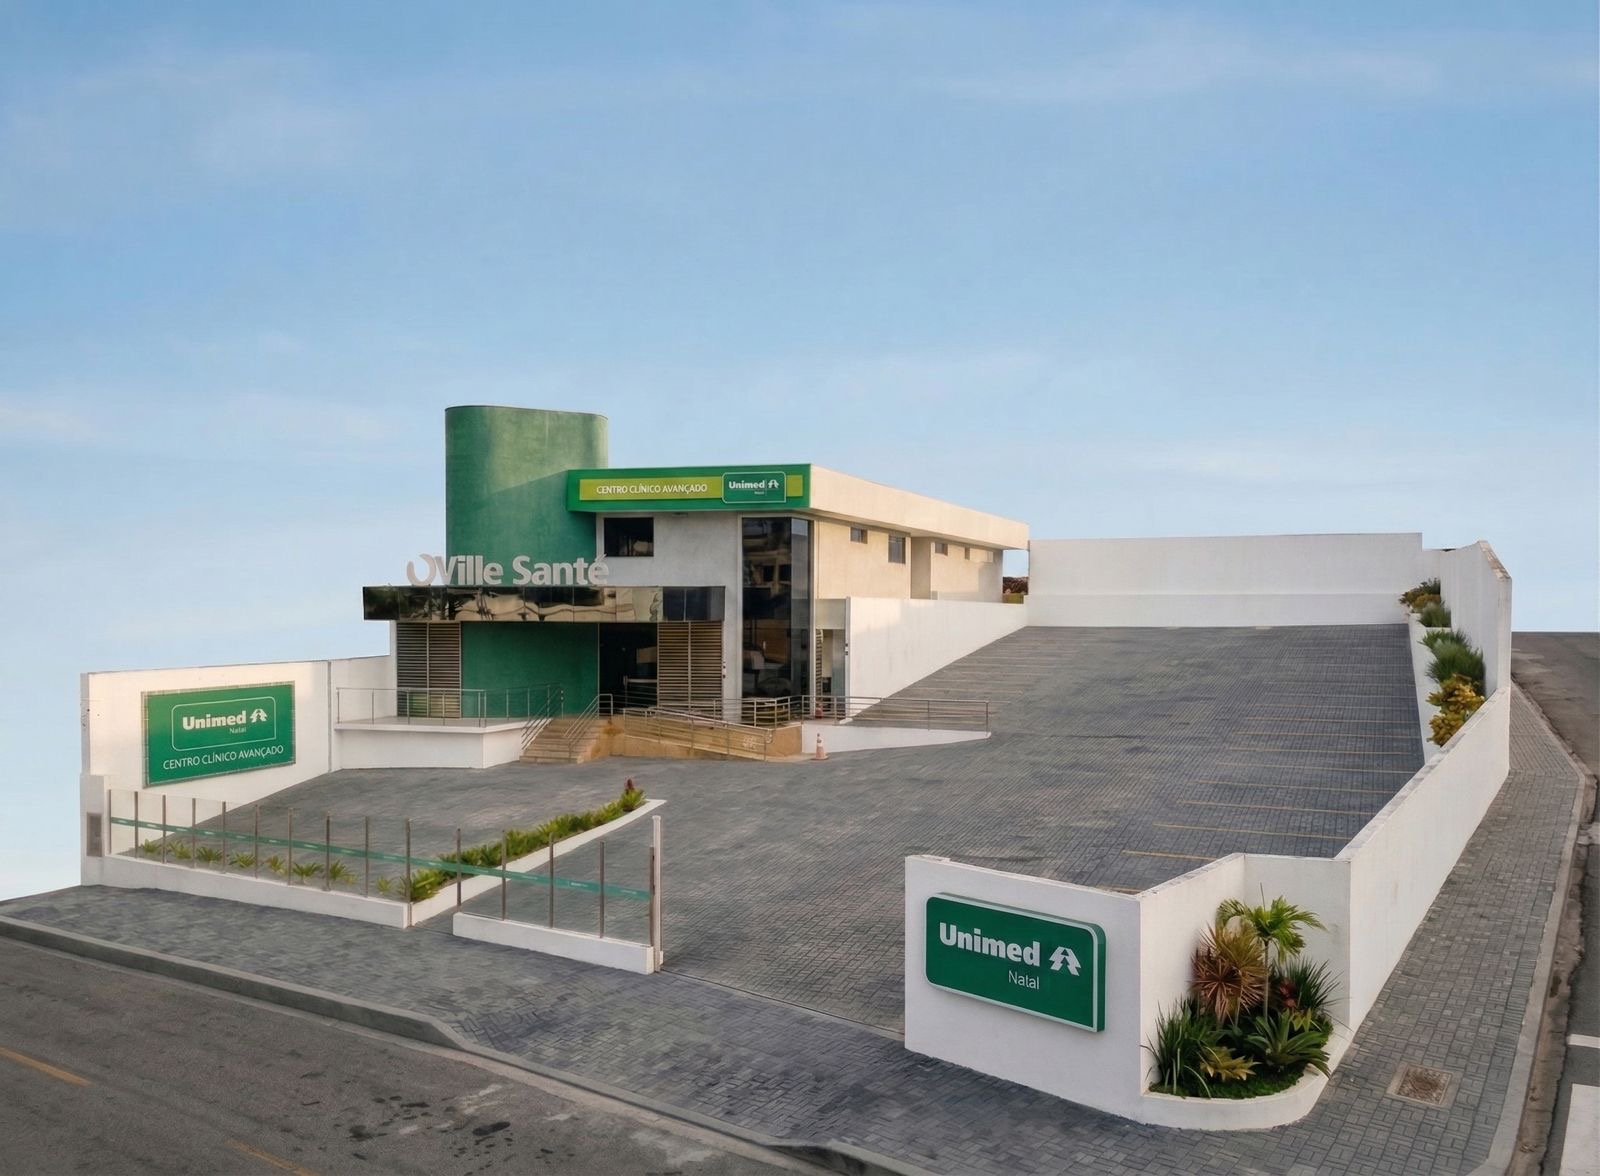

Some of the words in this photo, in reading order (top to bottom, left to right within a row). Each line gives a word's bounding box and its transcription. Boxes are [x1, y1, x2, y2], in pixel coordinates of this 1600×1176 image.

[596, 485, 628, 494] CENTRO
[629, 483, 661, 494] CLÍNICO
[662, 484, 708, 495] AVANÇADO
[728, 480, 765, 489] Unimed
[434, 554, 504, 586] Ville
[512, 553, 610, 586] Santé
[182, 710, 247, 731] Unimed
[163, 756, 201, 770] CENTRO
[201, 751, 237, 765] CLÍNICO
[238, 745, 284, 760] AVANÇADO
[939, 922, 1041, 967] Unimed
[1008, 970, 1040, 990] Natal
